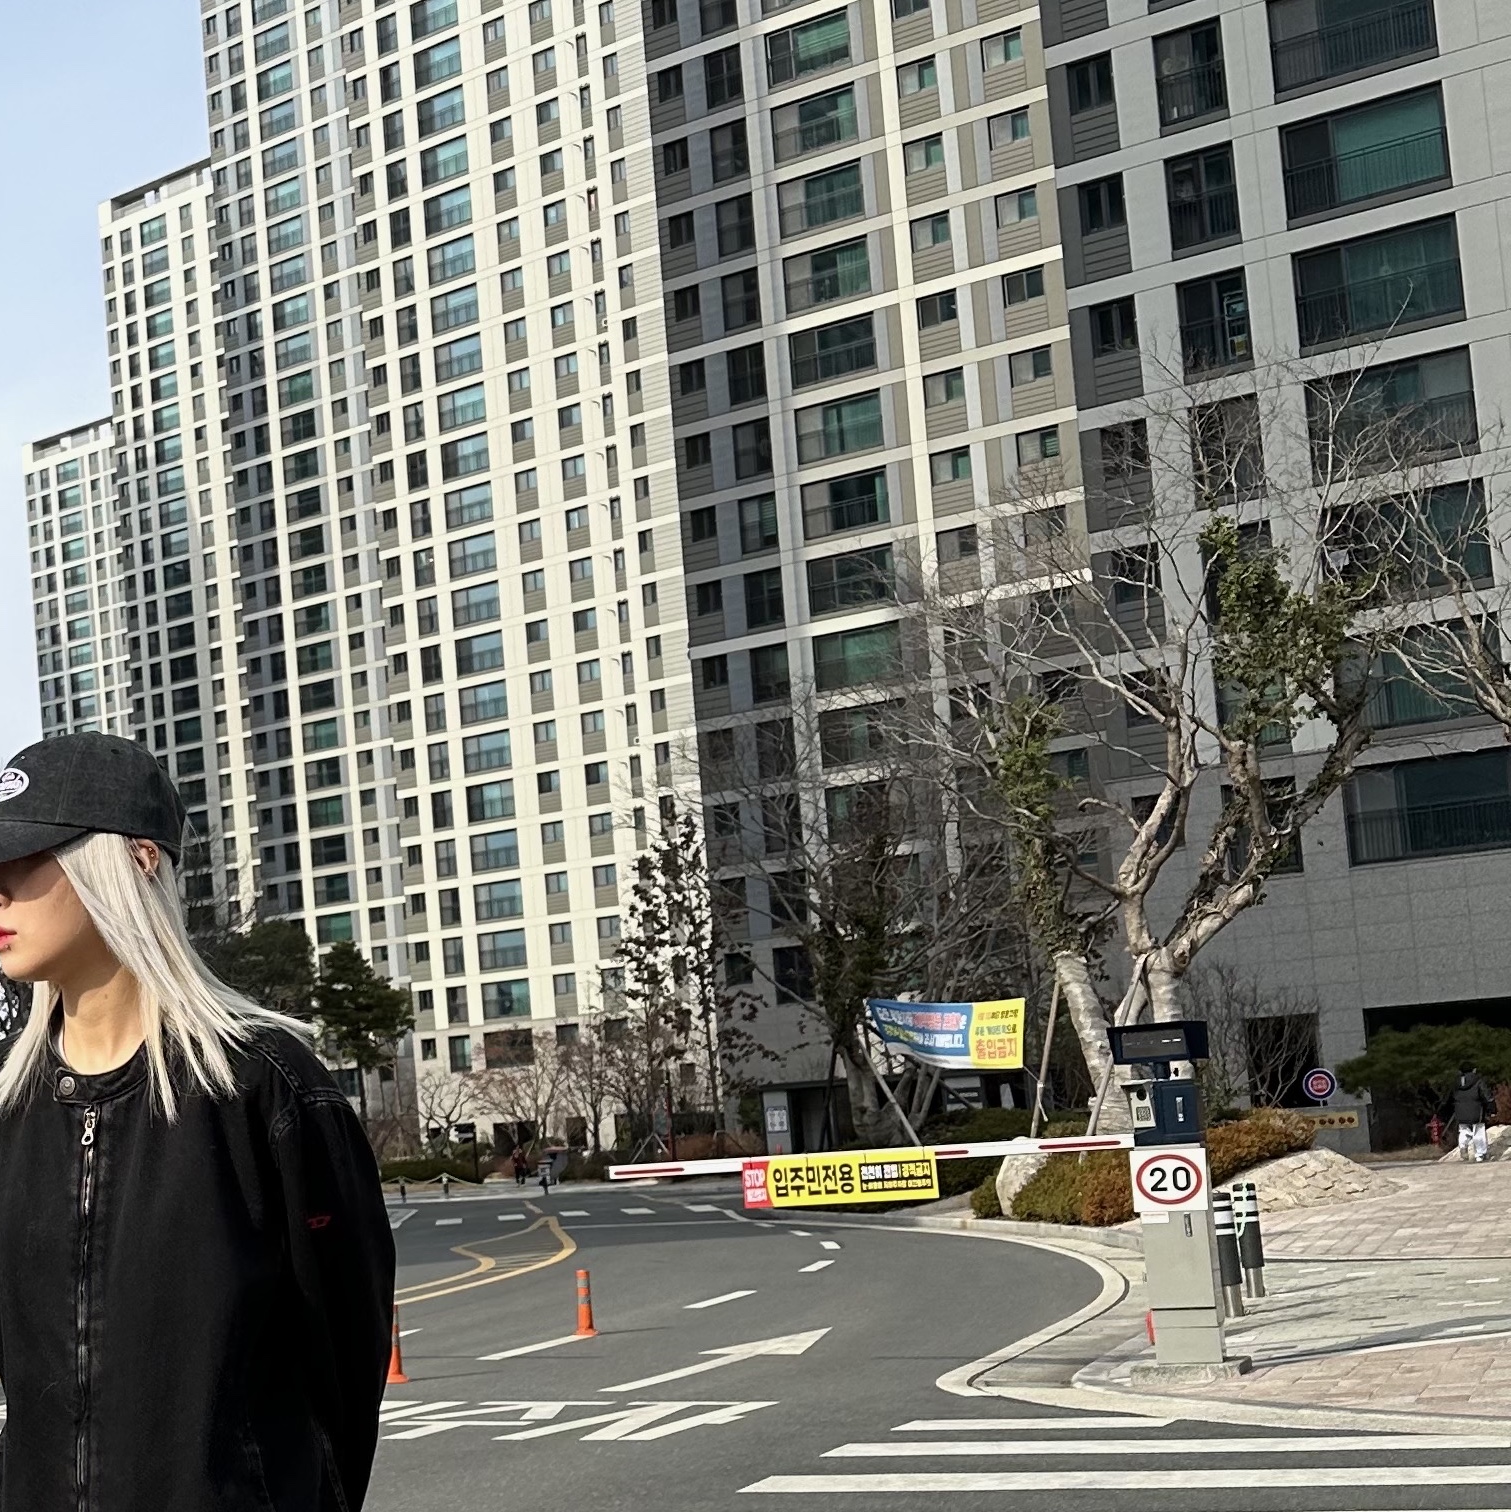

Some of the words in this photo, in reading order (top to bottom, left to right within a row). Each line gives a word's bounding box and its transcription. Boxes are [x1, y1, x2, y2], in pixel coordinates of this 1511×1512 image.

[975, 1038, 1018, 1060] 출입금지
[743, 1168, 767, 1188] STOP
[772, 1163, 856, 1198] 입주민전용
[1149, 1166, 1192, 1192] 20
